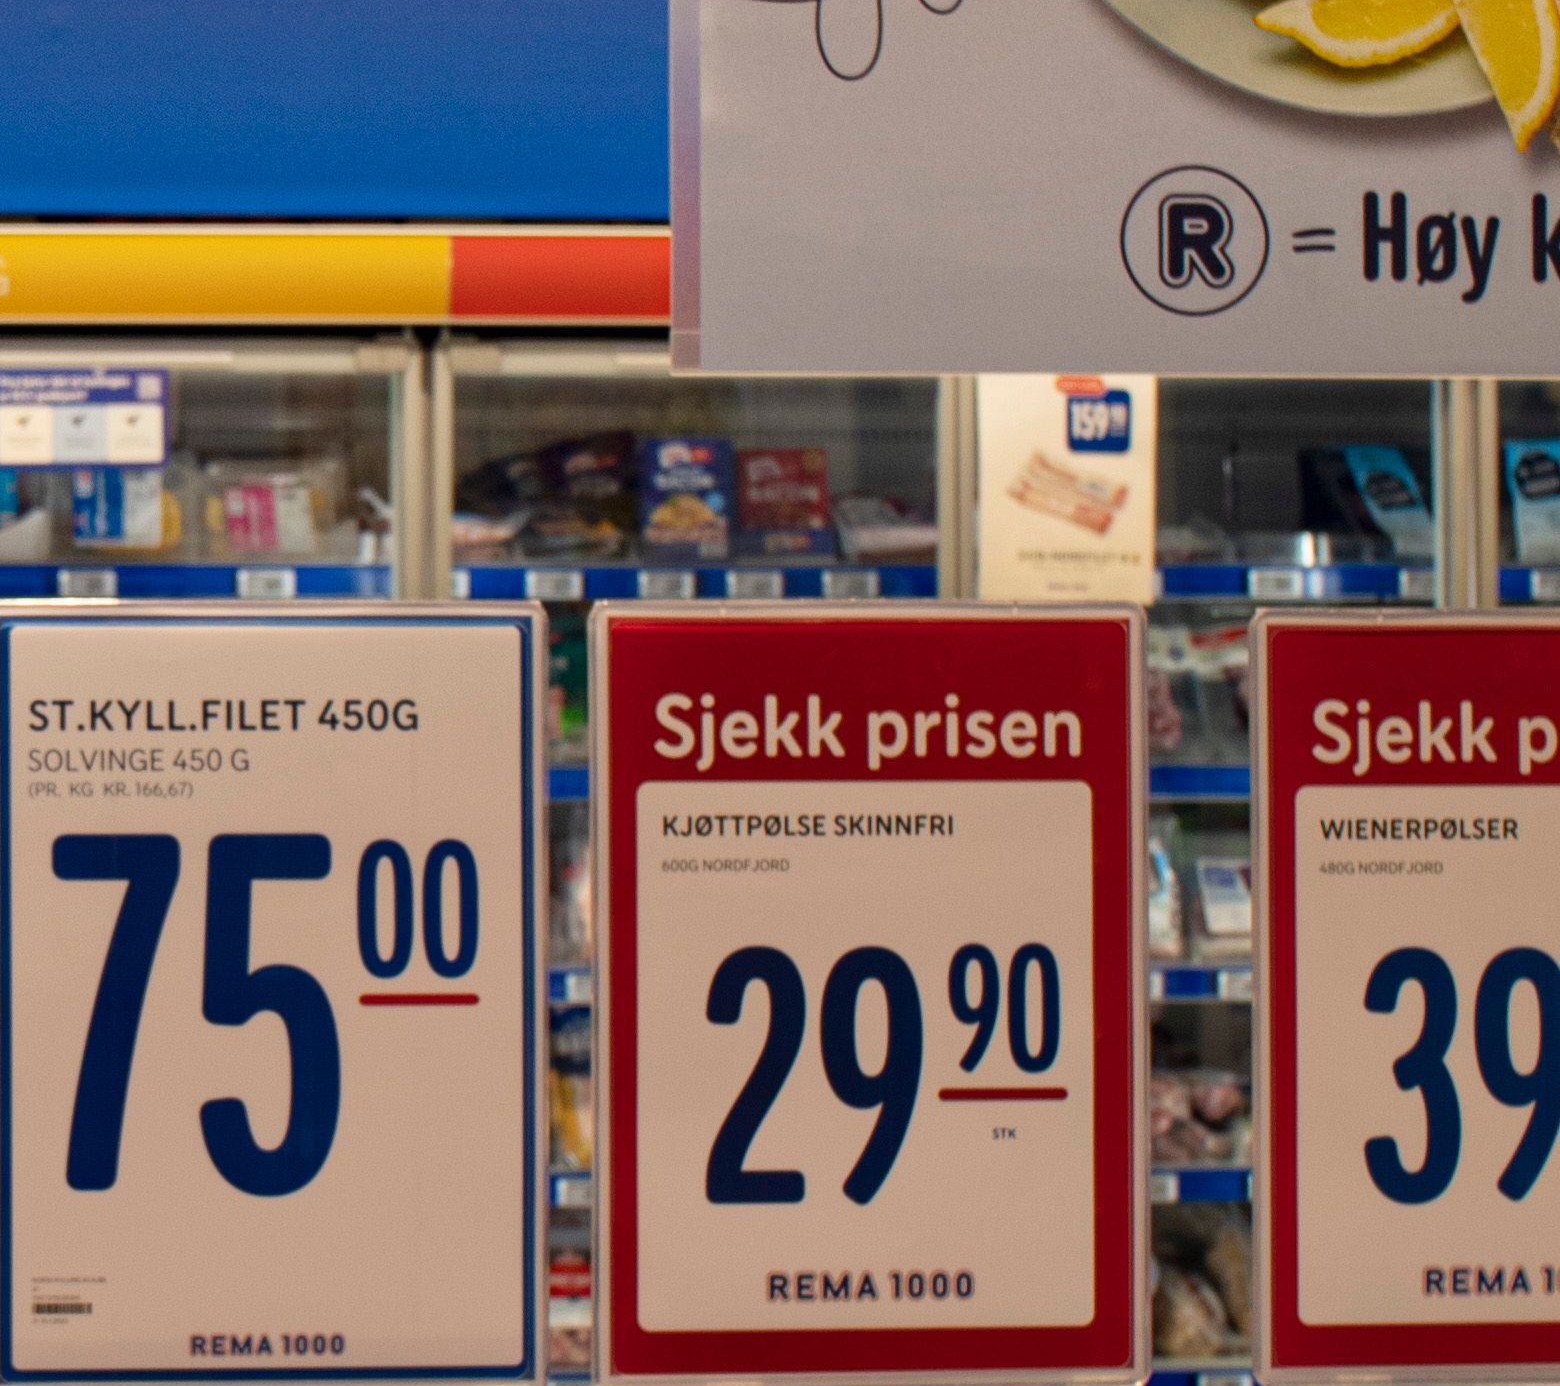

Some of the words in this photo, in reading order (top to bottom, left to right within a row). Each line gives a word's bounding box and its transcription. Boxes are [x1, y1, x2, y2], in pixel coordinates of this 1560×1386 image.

[1159, 199, 1235, 289] R
[1363, 191, 1500, 303] Høy
[30, 700, 306, 731] ST.KYLL.FILET
[318, 699, 418, 731] 450G
[654, 694, 845, 771] Sjekk
[868, 694, 1081, 770] prisen
[1312, 700, 1496, 775] Sjekk
[29, 748, 164, 772] SOLVINGE
[173, 748, 222, 772] 450
[230, 748, 249, 772] G
[69, 782, 94, 797] KG
[103, 782, 130, 796] KR.
[136, 781, 194, 798] 166,67)
[663, 815, 825, 837] KJØTTPØLSE
[834, 815, 953, 836] SKINNFRI
[1320, 818, 1518, 840] WIENERPØLSER
[661, 859, 699, 872] 600G
[703, 858, 790, 872] NORDFJORD
[1353, 861, 1443, 875] NORDFJORD
[52, 833, 340, 1197] 75
[357, 839, 479, 979] 00
[706, 946, 923, 1205] 29
[948, 943, 1060, 1073] 90
[769, 1274, 877, 1300] REMA
[891, 1272, 973, 1299] 1000
[1425, 1268, 1530, 1294] REMA
[190, 1335, 272, 1356] REMA
[282, 1334, 345, 1355] 1000
